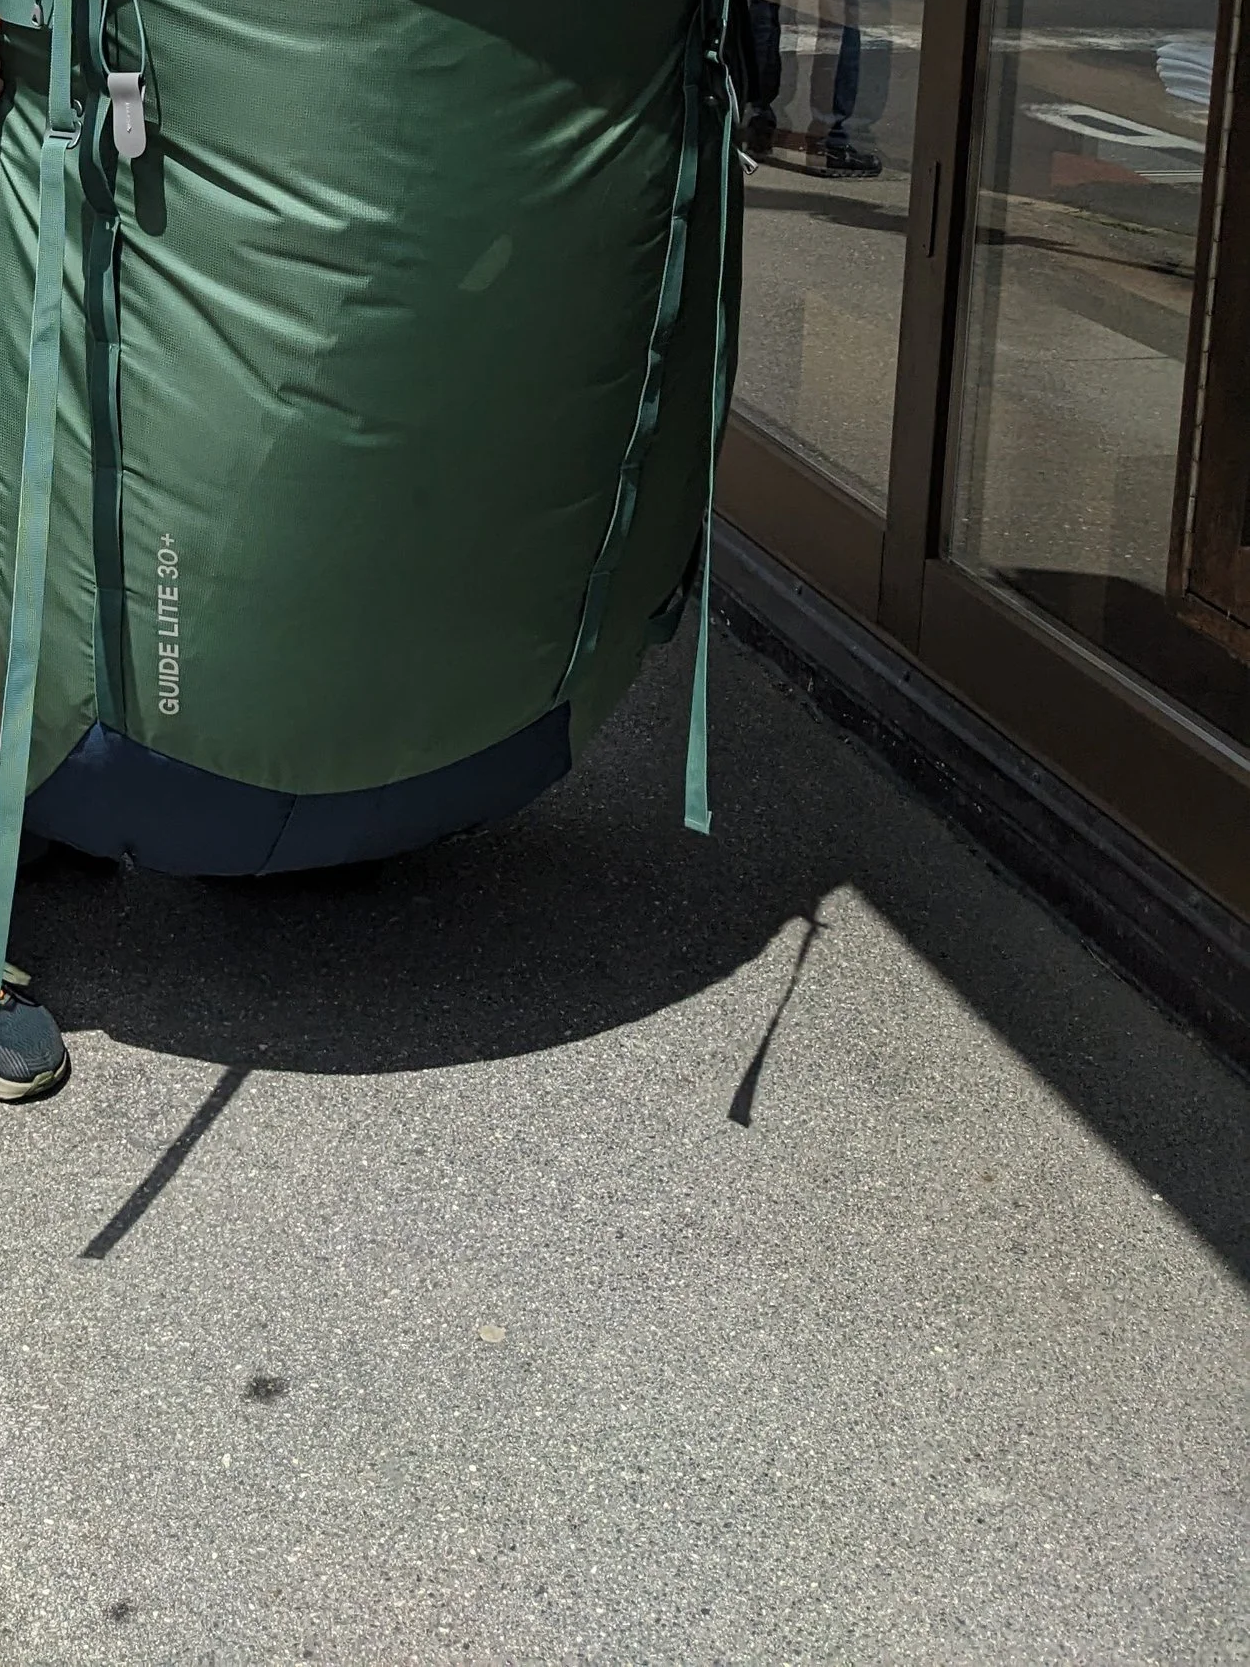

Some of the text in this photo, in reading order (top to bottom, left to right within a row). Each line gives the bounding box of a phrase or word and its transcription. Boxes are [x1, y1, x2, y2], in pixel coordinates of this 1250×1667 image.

[158, 533, 180, 716] GUIDE LITE 30+
